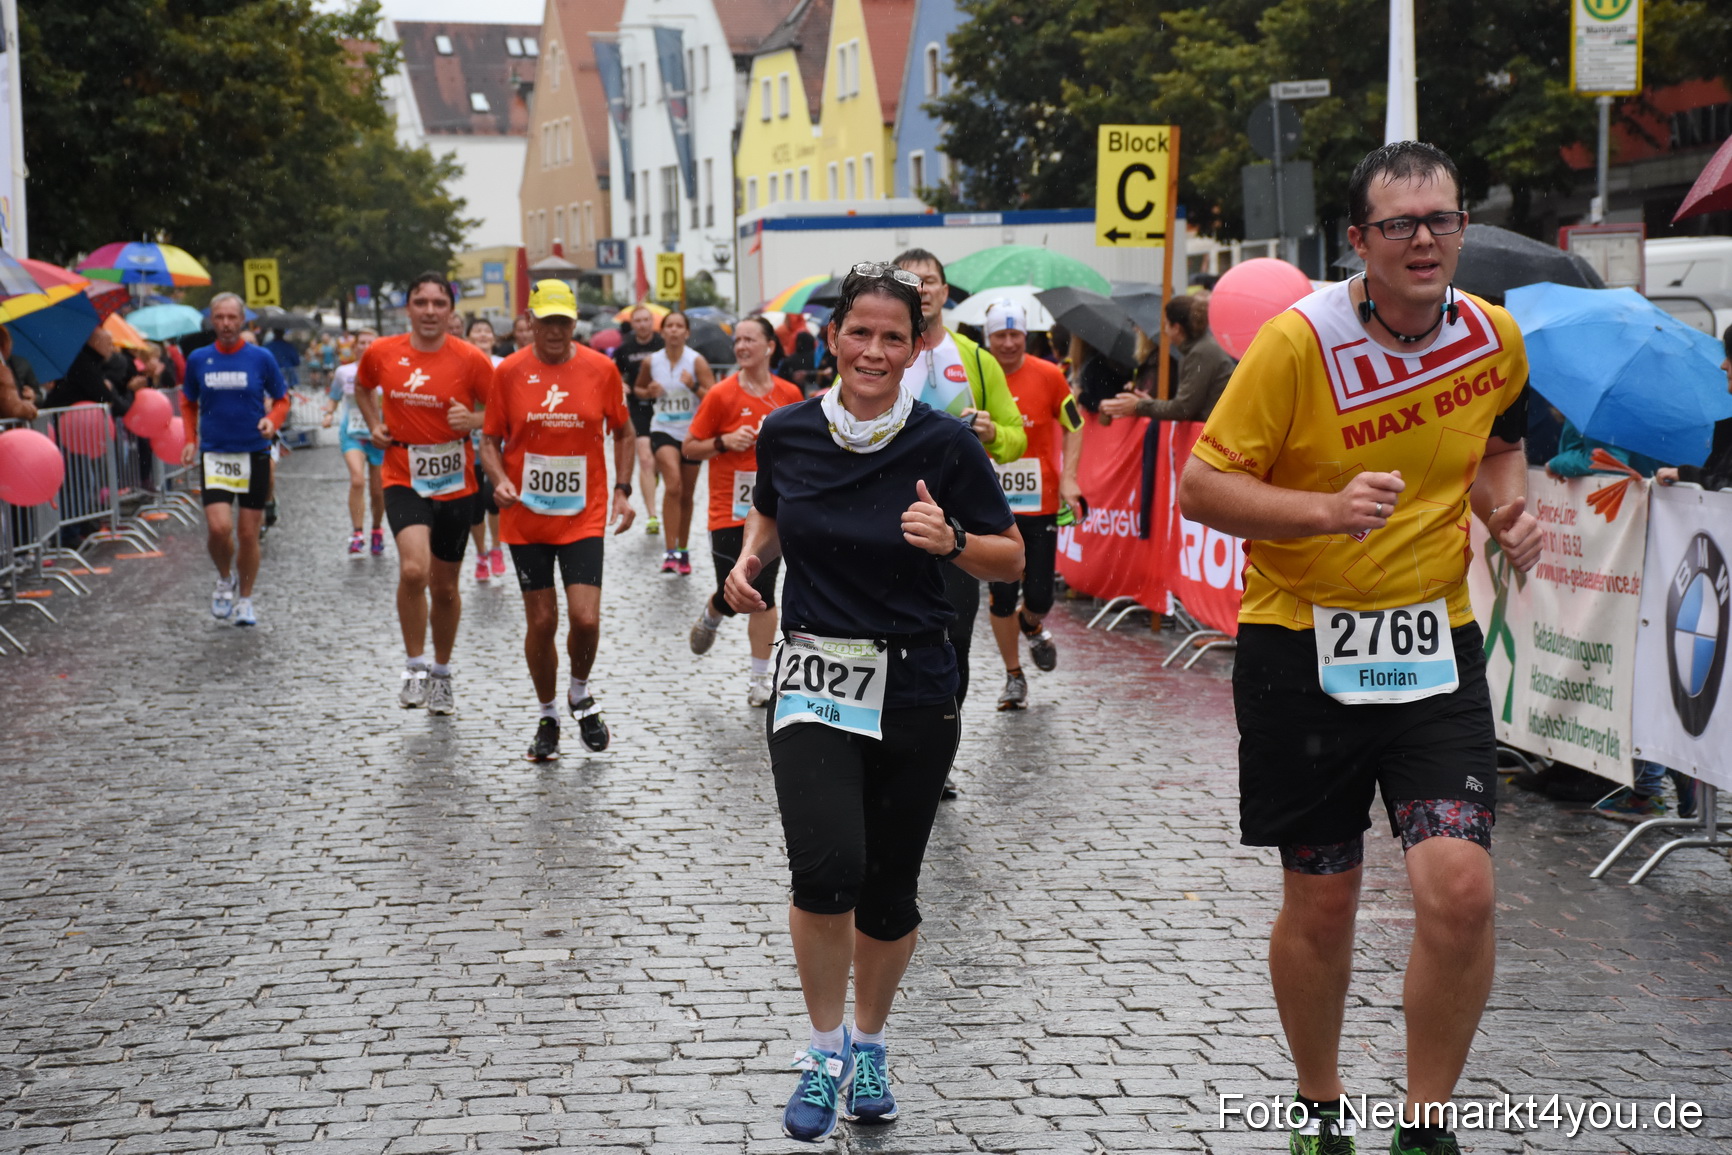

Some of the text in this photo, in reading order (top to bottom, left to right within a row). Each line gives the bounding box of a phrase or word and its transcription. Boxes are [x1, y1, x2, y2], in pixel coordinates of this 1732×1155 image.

[1108, 131, 1170, 153] Block
[1117, 163, 1156, 221] C
[254, 274, 270, 297] D
[663, 266, 678, 290] D
[389, 389, 437, 402] funrunners
[526, 411, 578, 422] funrunners
[1341, 366, 1508, 450] MAX BÖGL
[541, 419, 585, 429] neumarkt
[415, 453, 462, 477] 2698
[528, 469, 580, 493] 3085
[1674, 536, 1730, 607] BMW
[1331, 609, 1440, 659] 2769
[779, 653, 877, 702] 2027
[1359, 668, 1418, 688] Florian
[1465, 780, 1484, 793] PRO
